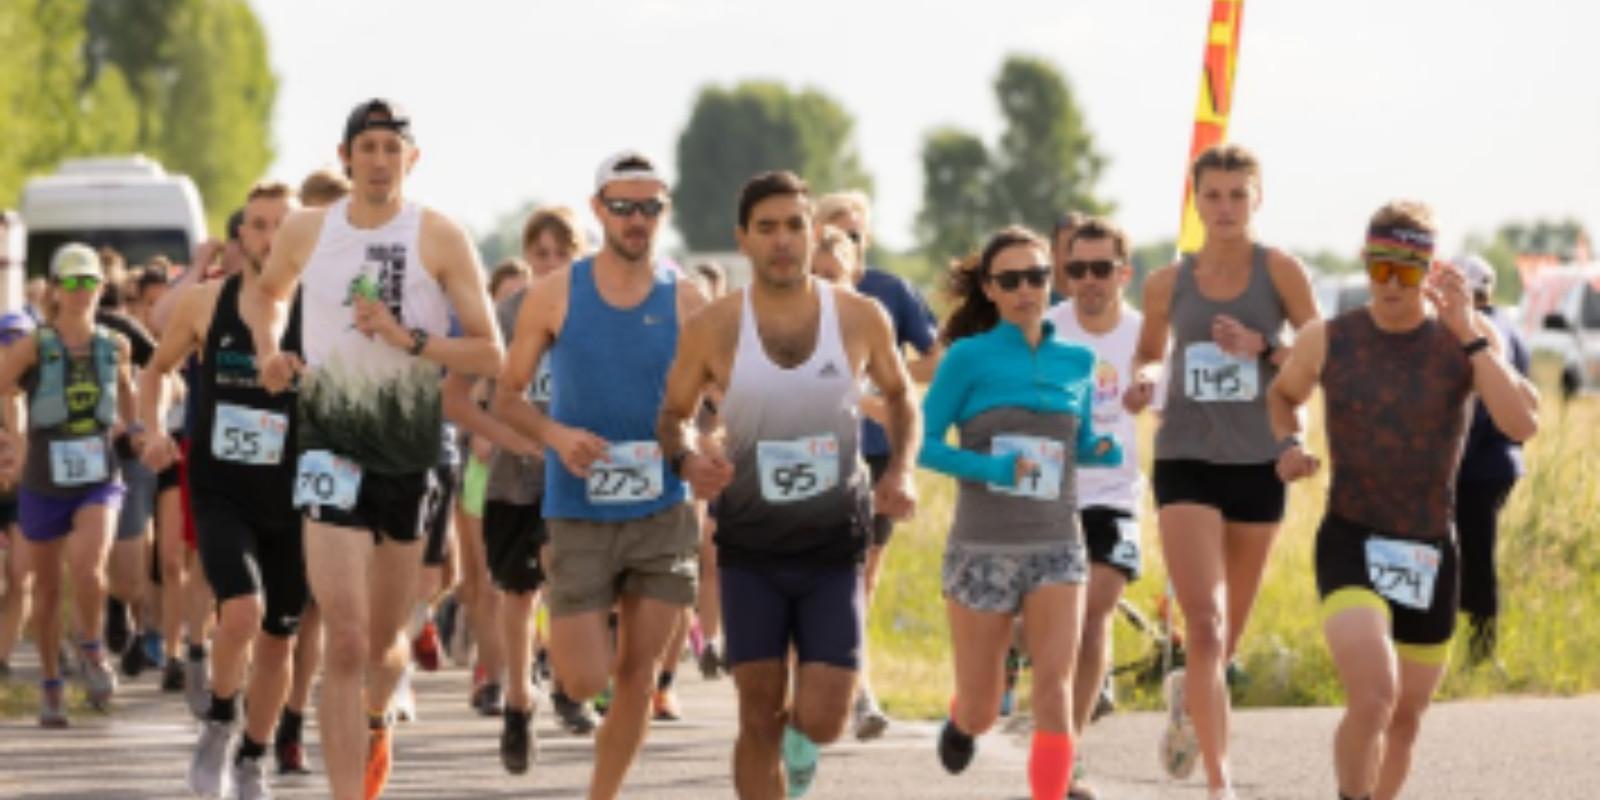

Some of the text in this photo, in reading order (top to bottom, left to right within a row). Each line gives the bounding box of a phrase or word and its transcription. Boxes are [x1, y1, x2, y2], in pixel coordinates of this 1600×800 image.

[1191, 366, 1240, 396] 145
[223, 426, 261, 455] 55
[589, 466, 650, 496] 275
[773, 462, 817, 496] 95
